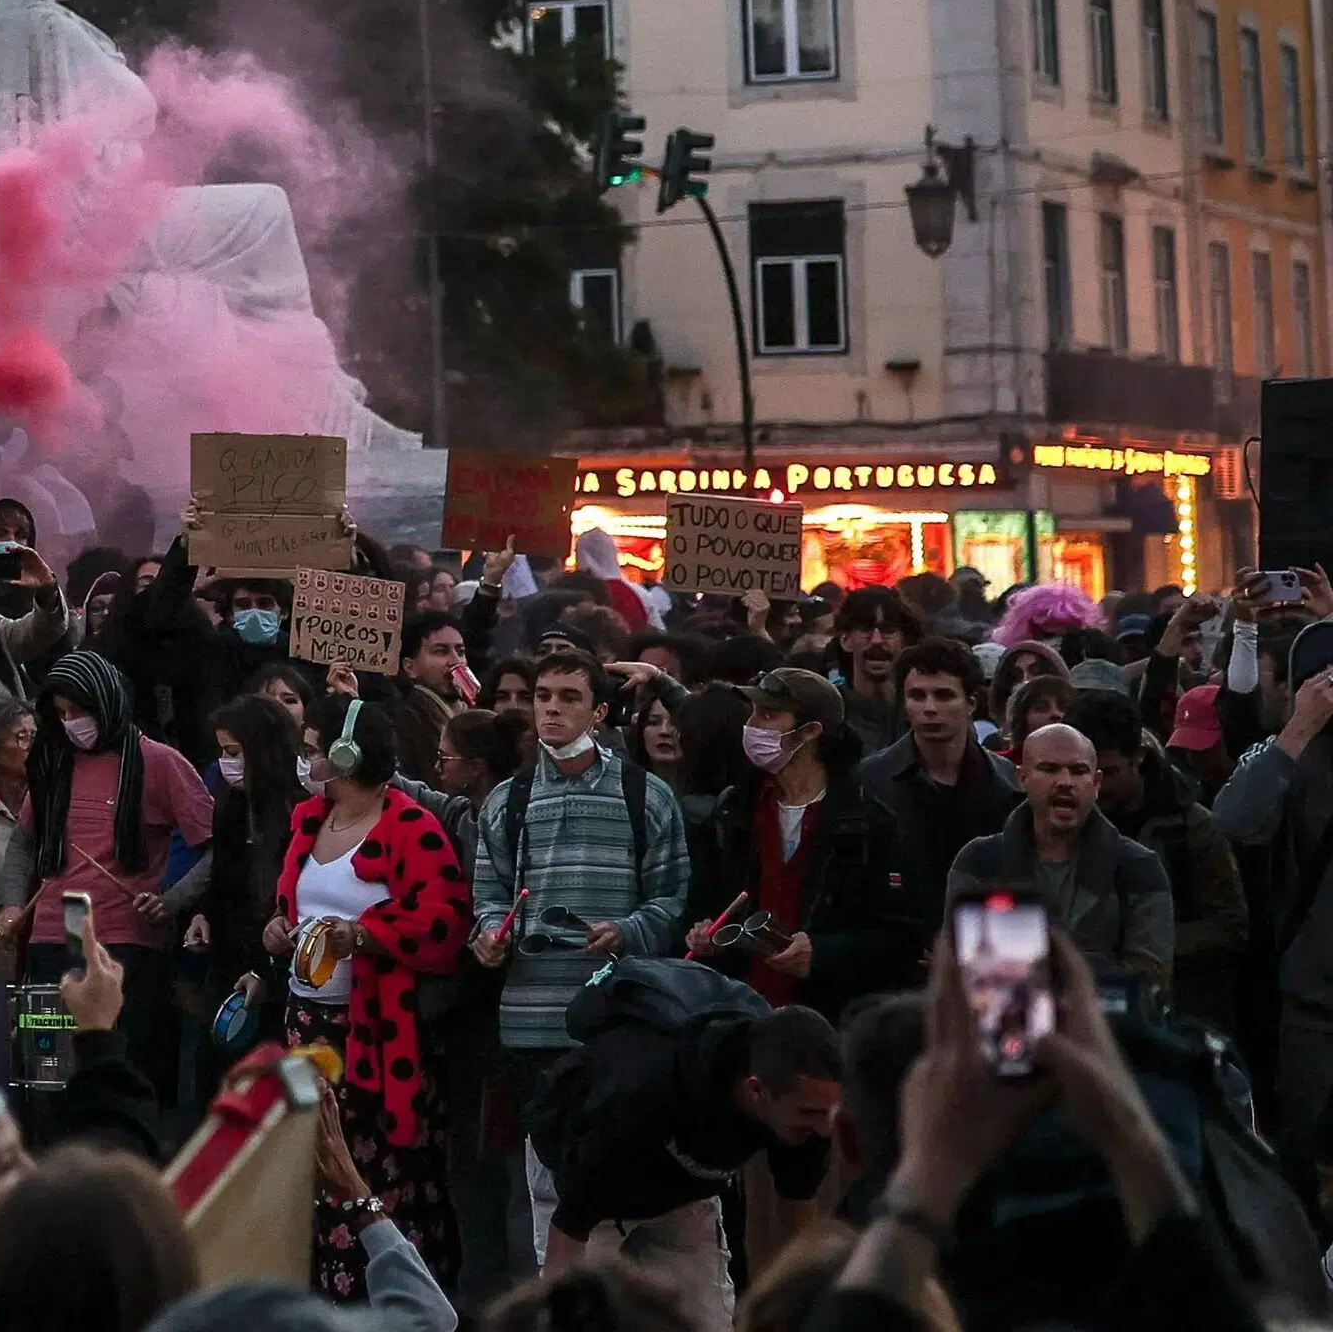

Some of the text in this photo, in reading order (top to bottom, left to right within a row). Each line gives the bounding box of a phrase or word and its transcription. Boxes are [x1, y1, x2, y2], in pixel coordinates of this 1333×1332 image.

[575, 472, 600, 493] A
[786, 463, 996, 494] PORTUGUESA
[671, 503, 799, 535] TUDO O QUE
[673, 534, 800, 561] O POVO QUER
[672, 563, 801, 594] O POVO TEM
[306, 615, 379, 644] PORCOS
[311, 638, 366, 663] MERDA
